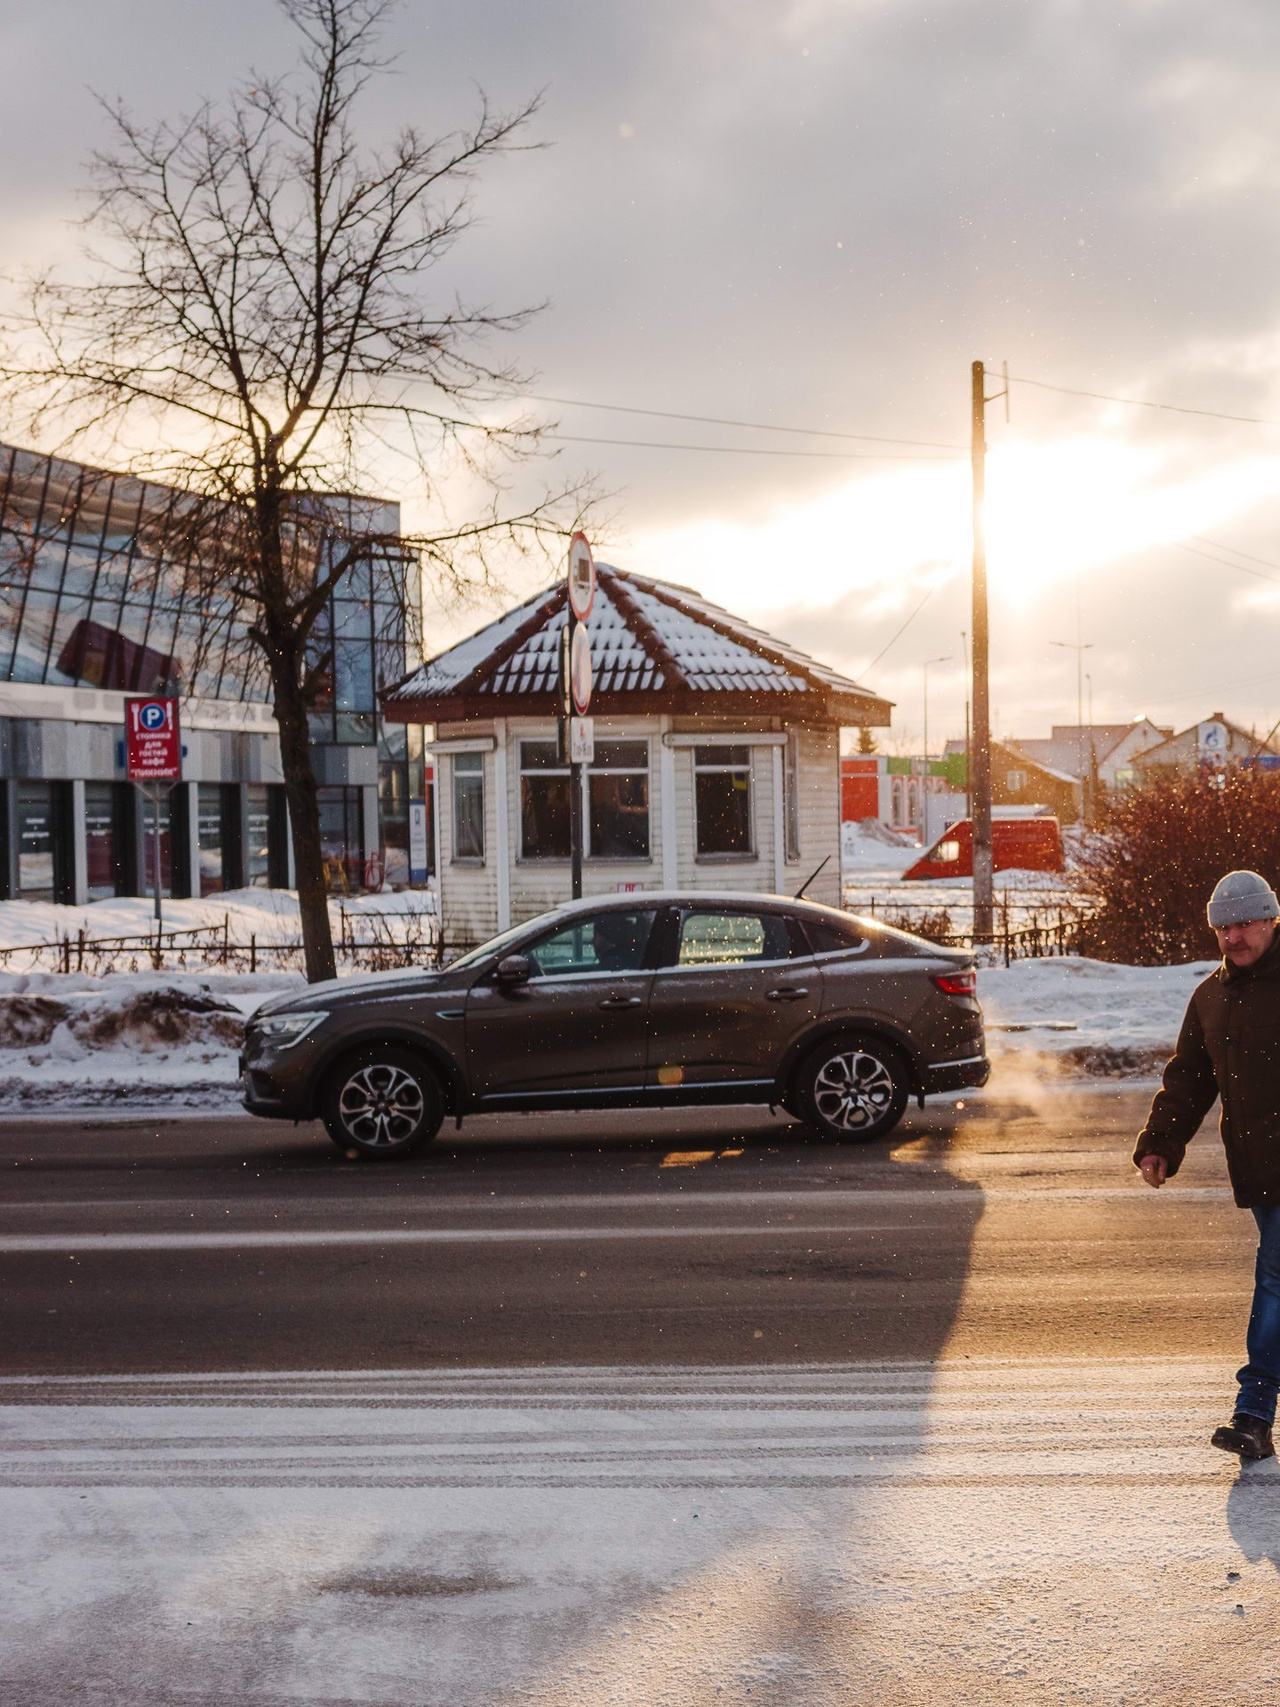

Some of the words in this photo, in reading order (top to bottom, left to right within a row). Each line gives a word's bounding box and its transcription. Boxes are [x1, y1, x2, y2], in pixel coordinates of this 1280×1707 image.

[147, 708, 160, 726] P
[138, 748, 168, 757] гостей
[142, 757, 165, 766] кафе
